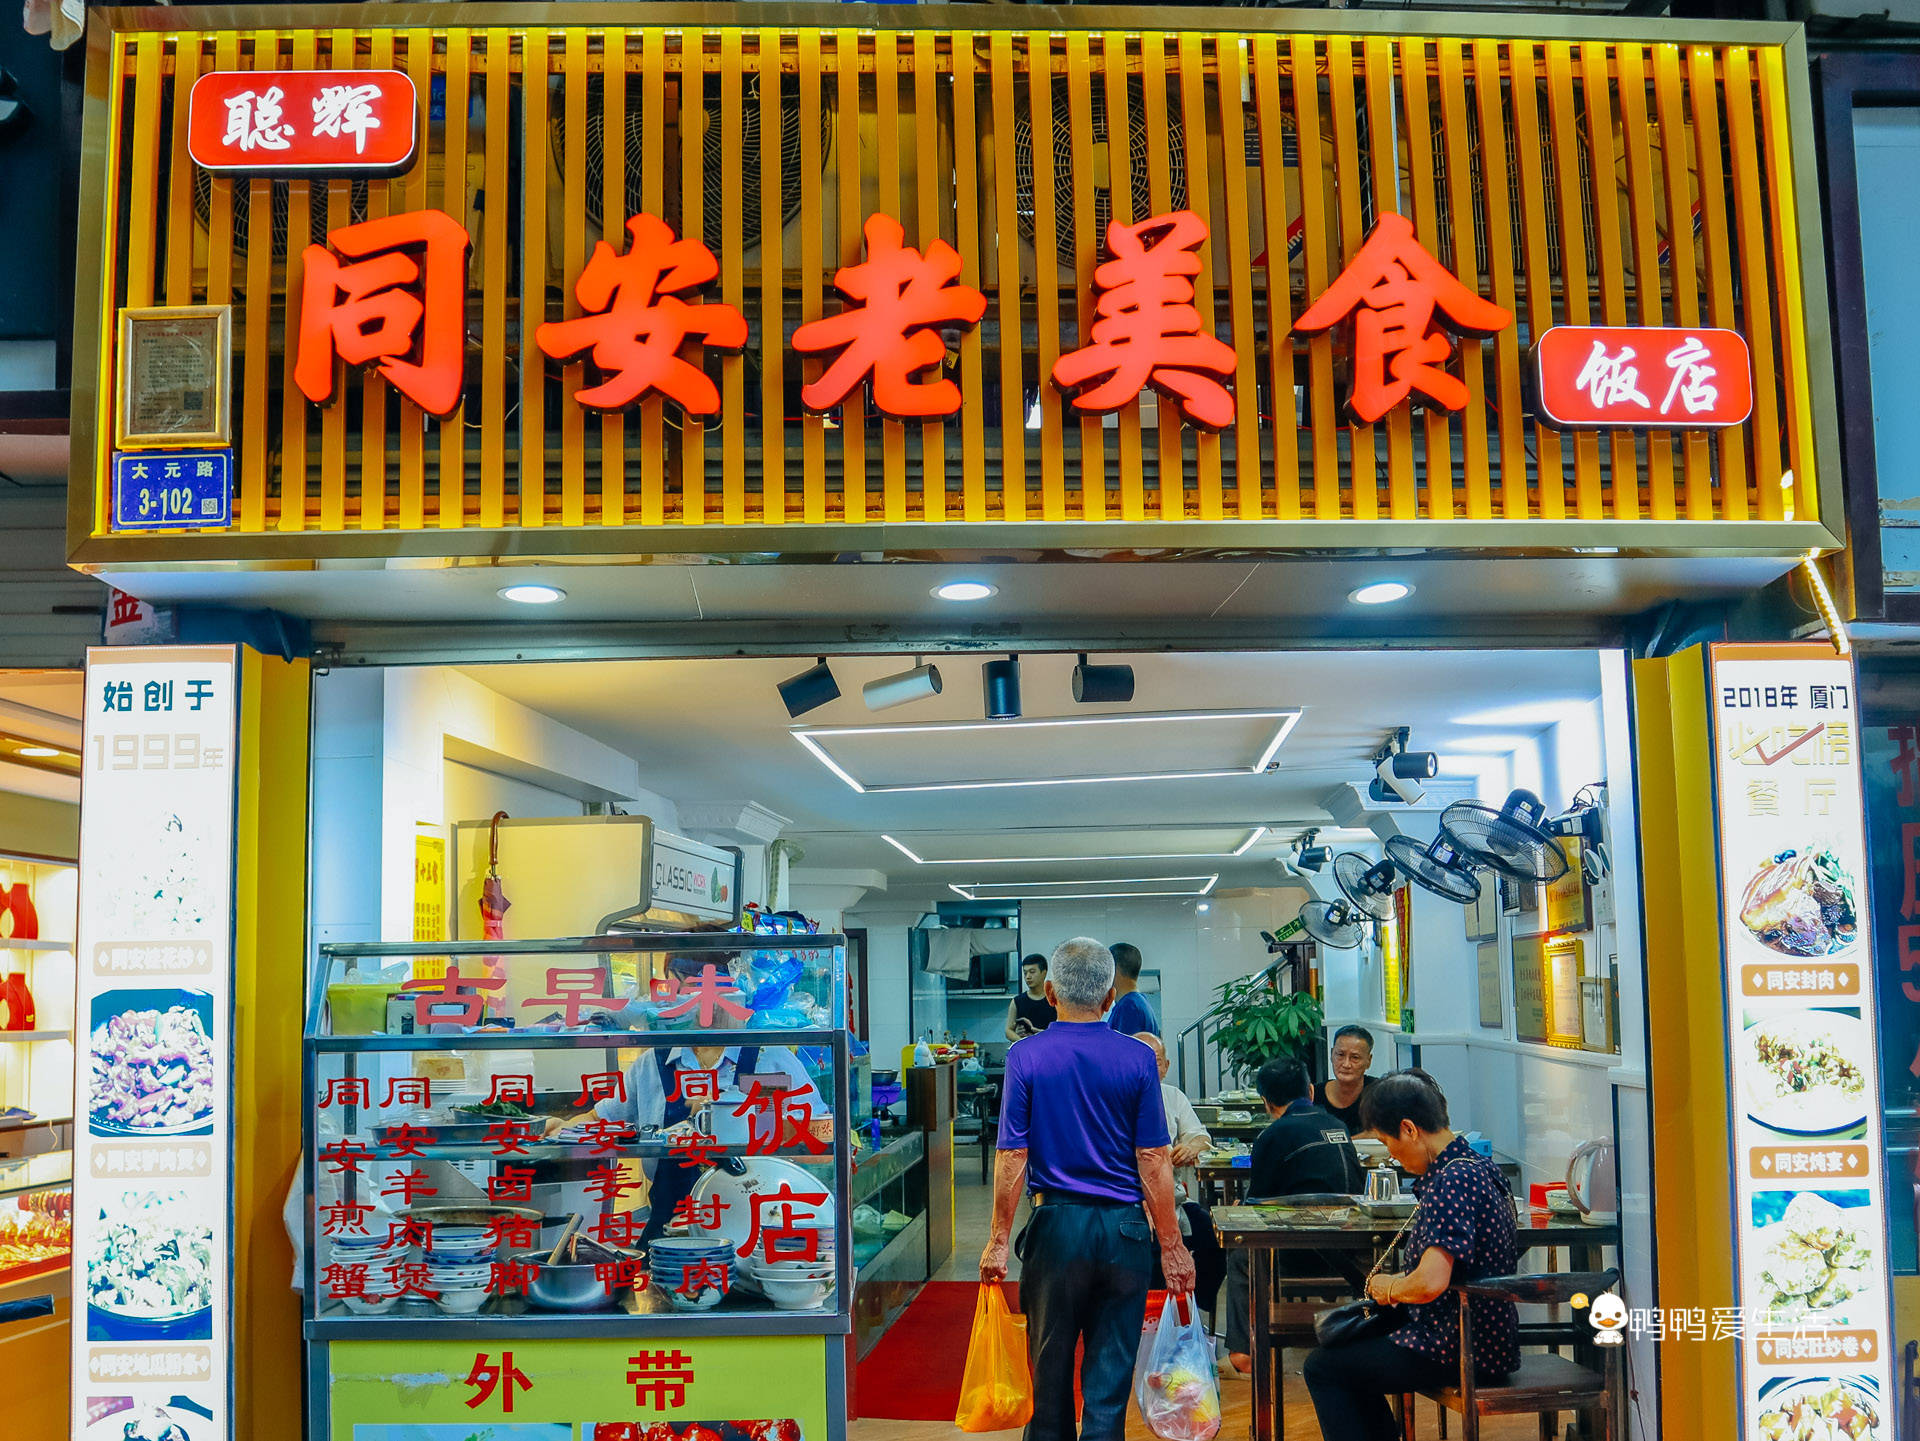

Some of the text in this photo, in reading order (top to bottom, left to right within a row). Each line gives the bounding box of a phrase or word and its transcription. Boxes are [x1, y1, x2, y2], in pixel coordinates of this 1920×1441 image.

[221, 85, 383, 155] 聪辉
[294, 209, 1513, 430] 同安老美食
[1576, 337, 1718, 415] 饭店
[131, 461, 214, 479] 大元路
[139, 488, 193, 515] 3-102
[103, 680, 214, 712] 始创于
[1723, 685, 1849, 709] 2018年 厦门
[93, 733, 224, 771] 1999年
[1745, 779, 1836, 816] 餐厅
[655, 862, 693, 893] CLASSIC
[401, 963, 754, 1027] 古早味
[1767, 970, 1835, 991] 同安封肉
[318, 1077, 376, 1299] 同安煎蟹
[379, 1077, 440, 1300] 同安羊肉煲
[481, 1074, 541, 1296] 同安卤猪脚
[573, 1070, 649, 1296] 同安姜母鸭
[666, 1069, 731, 1294] 同安封肉
[732, 1080, 829, 1265] 饭店
[464, 1349, 694, 1412] 外带
